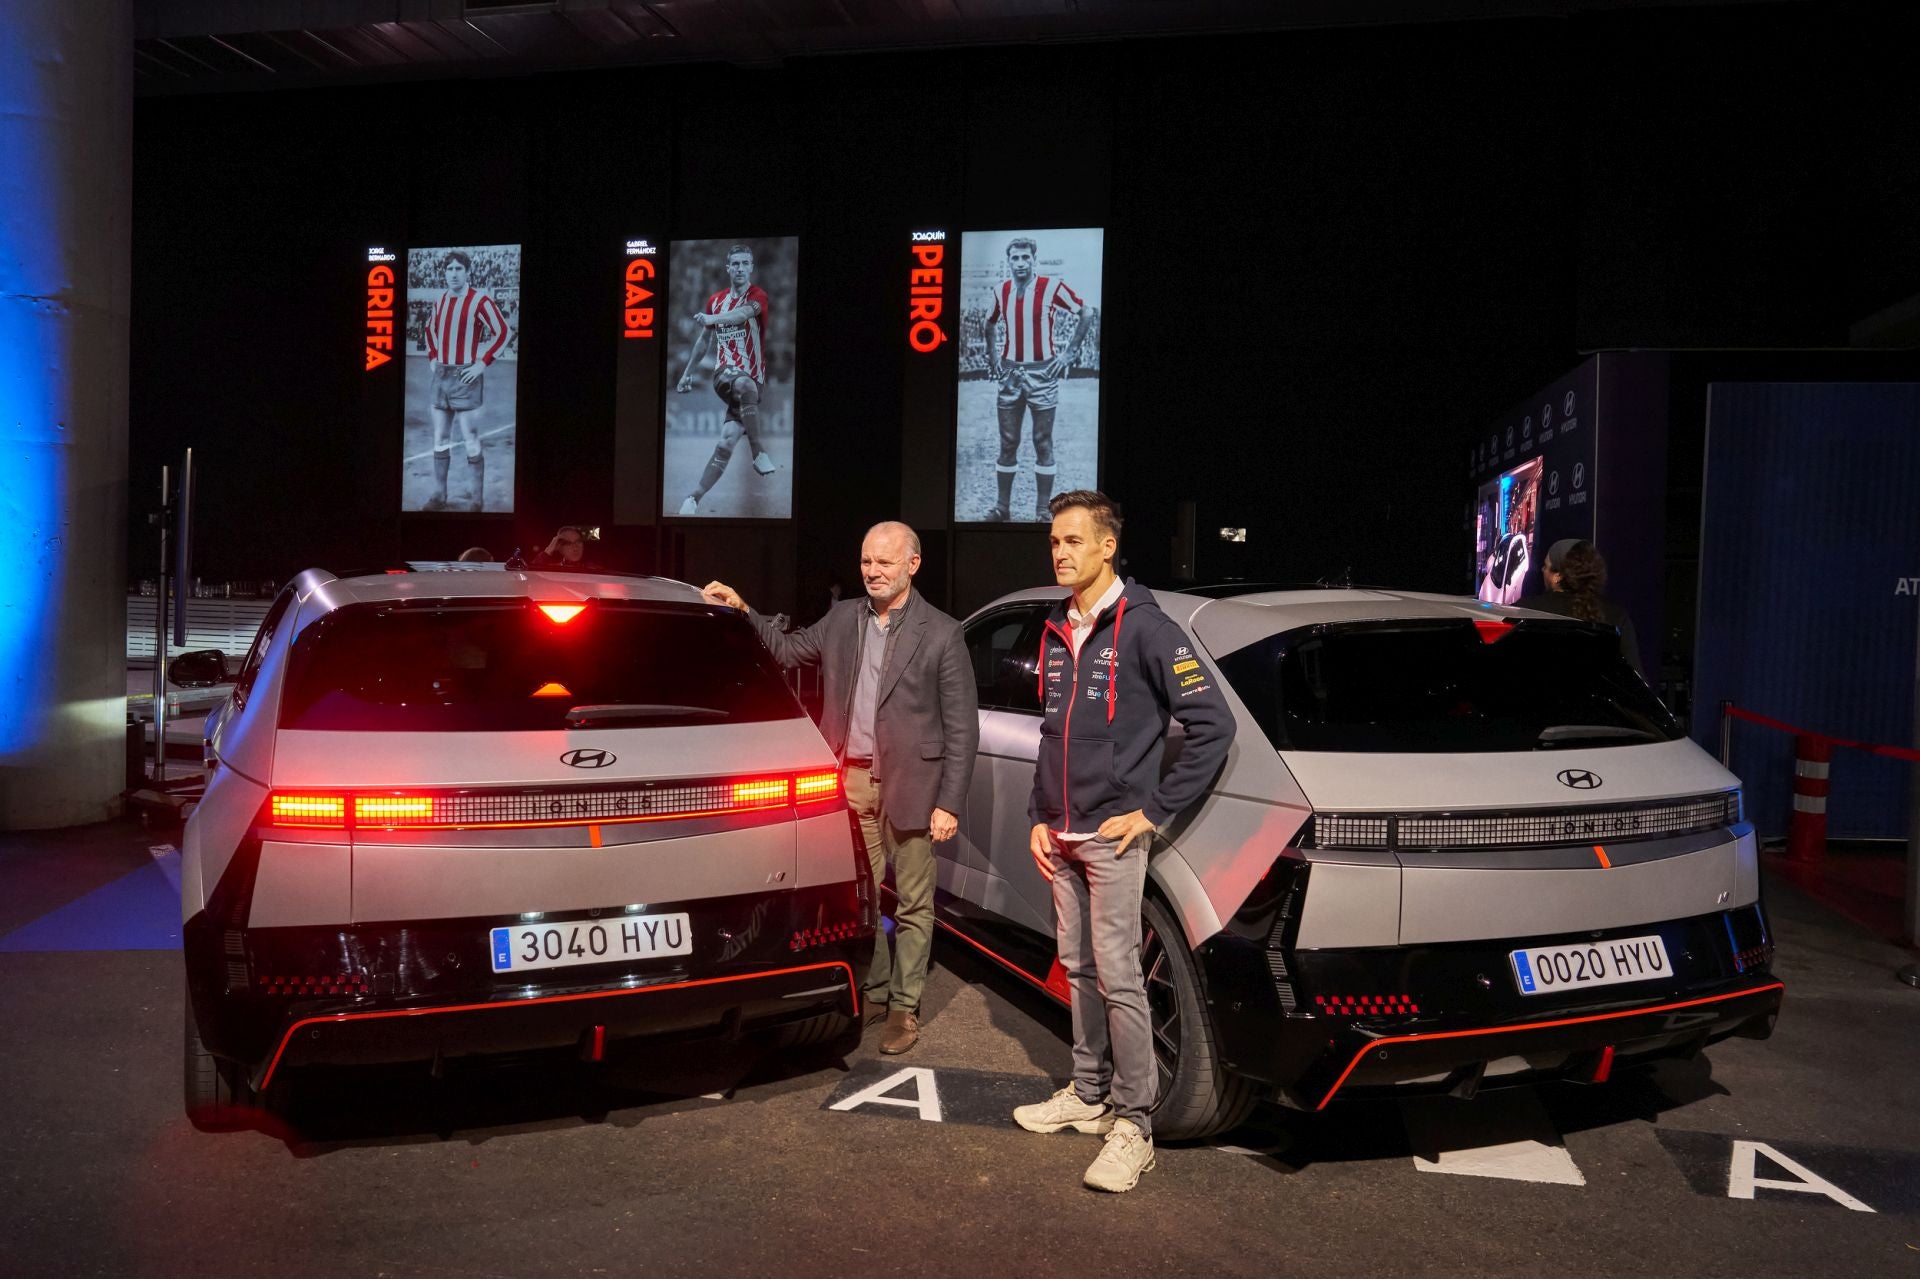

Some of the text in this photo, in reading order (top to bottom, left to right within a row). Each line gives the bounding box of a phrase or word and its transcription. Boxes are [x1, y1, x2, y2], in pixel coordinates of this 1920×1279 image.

[626, 240, 649, 248] GABRIEL
[912, 231, 946, 242] JOAQUÍN
[368, 247, 385, 255] JORGE
[368, 254, 396, 262] BERNARDO
[626, 247, 657, 255] FERNÁNDEZ
[624, 259, 655, 338] GABI
[909, 245, 948, 353] PEIRÓ
[366, 265, 395, 371] GRIFFA
[521, 925, 608, 963] 3040
[621, 918, 683, 954] HYU
[498, 953, 507, 963] E
[1536, 940, 1663, 985] 0020 HYU
[1524, 975, 1532, 985] E
[828, 1066, 943, 1122] A
[1727, 1140, 1879, 1214] A
